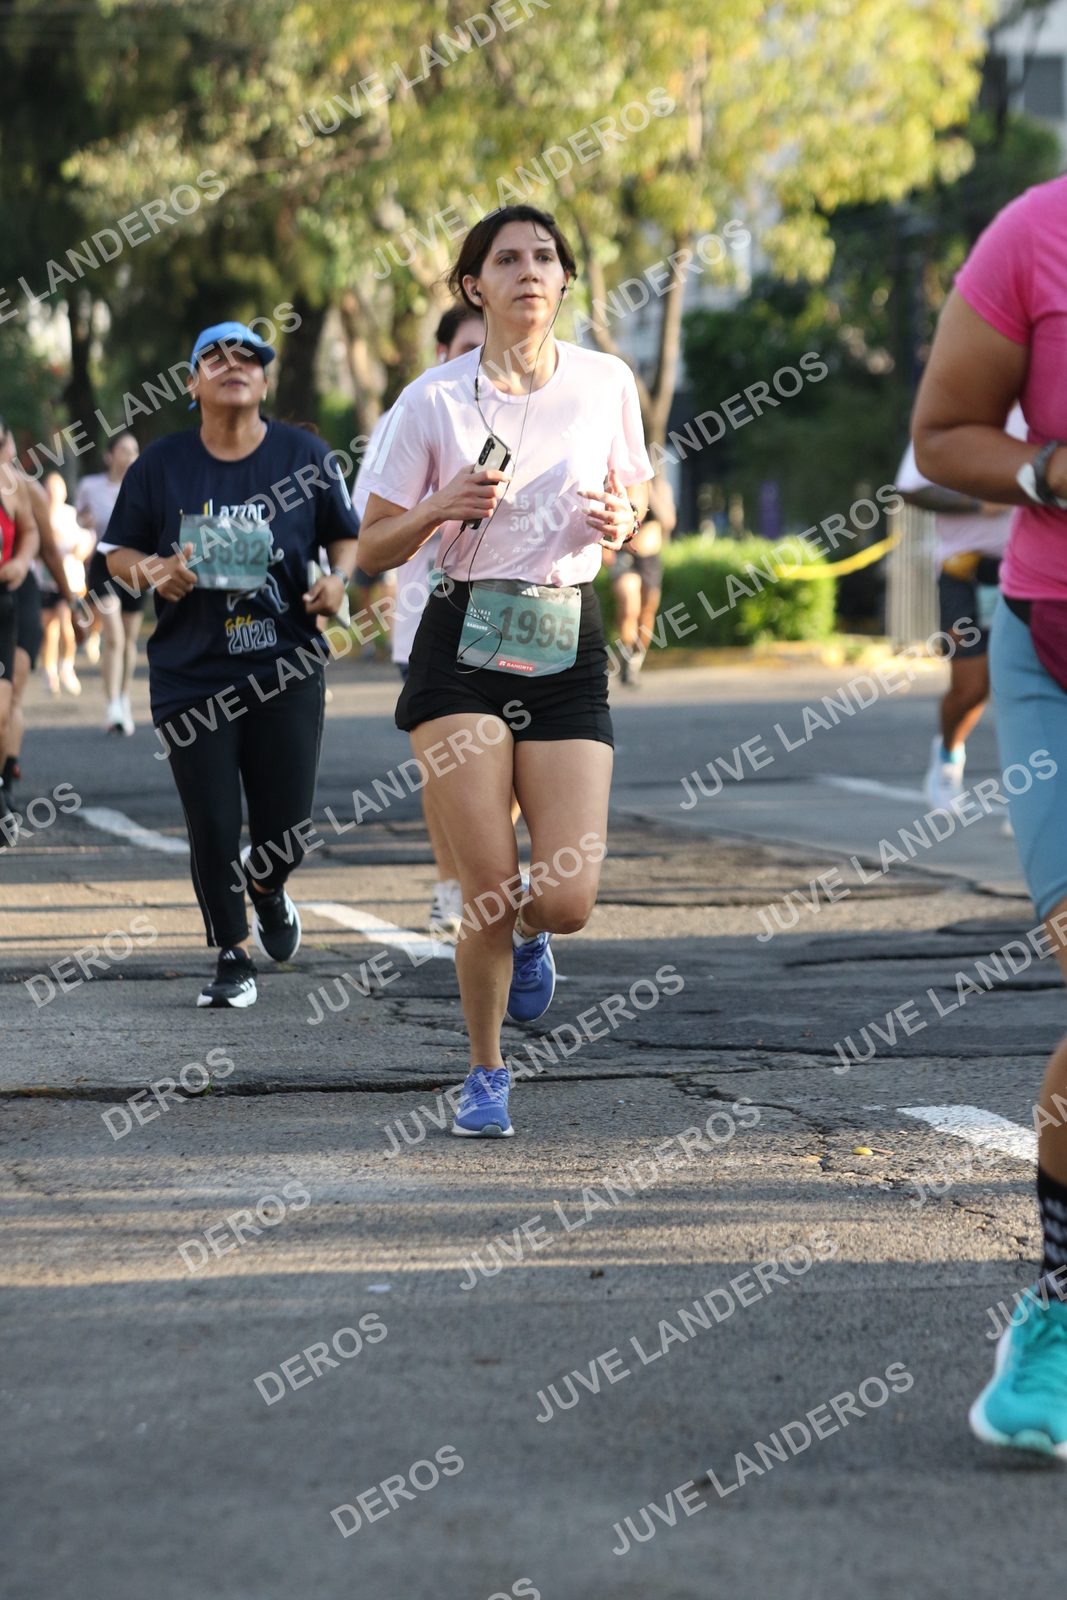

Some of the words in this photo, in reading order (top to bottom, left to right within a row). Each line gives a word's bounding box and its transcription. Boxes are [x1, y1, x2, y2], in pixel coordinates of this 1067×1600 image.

[509, 516, 529, 532] 30
[226, 618, 277, 655] 2026
[498, 606, 575, 651] 1995
